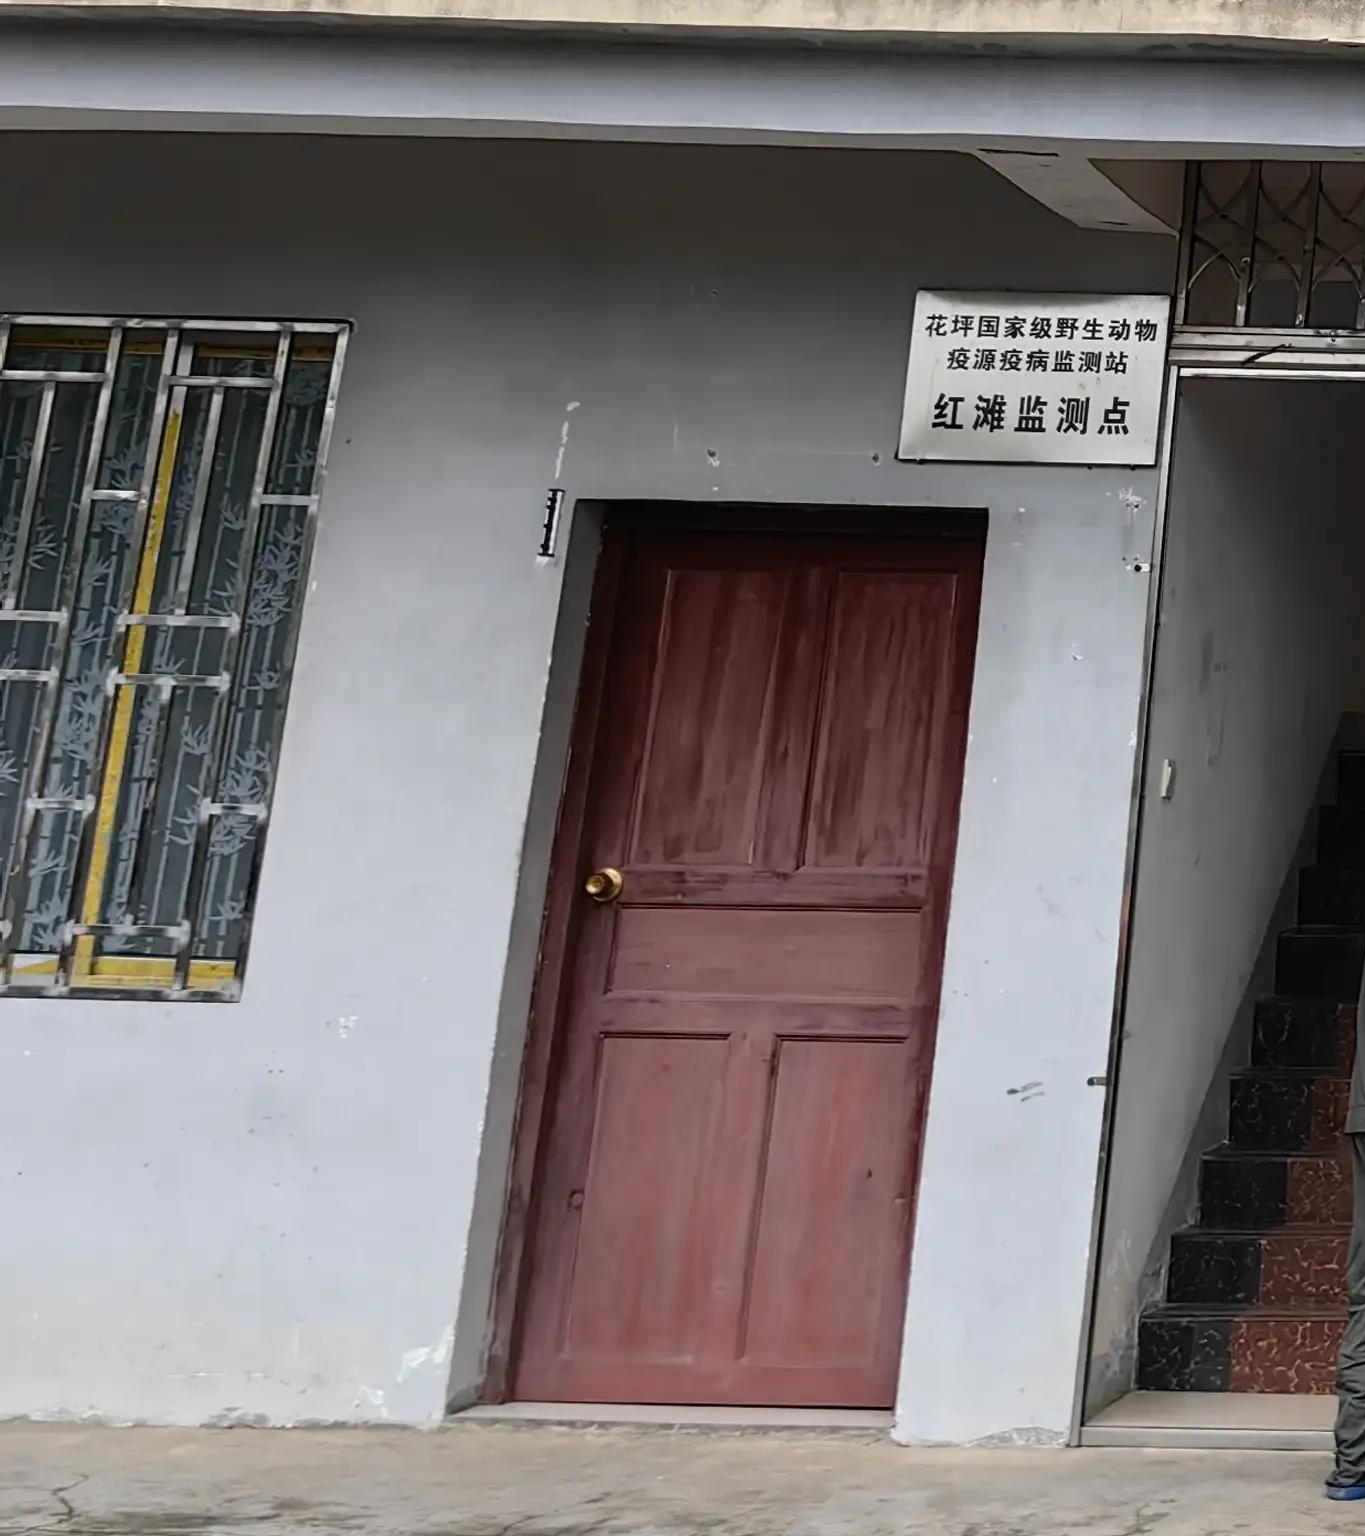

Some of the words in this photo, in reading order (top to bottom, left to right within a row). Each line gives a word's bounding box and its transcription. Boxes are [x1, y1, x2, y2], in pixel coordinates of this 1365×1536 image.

[924, 313, 1158, 342] 花坪国家级野生动物
[946, 347, 1129, 375] 疫源疫病监测站
[931, 392, 1131, 436] 红滩监测点
